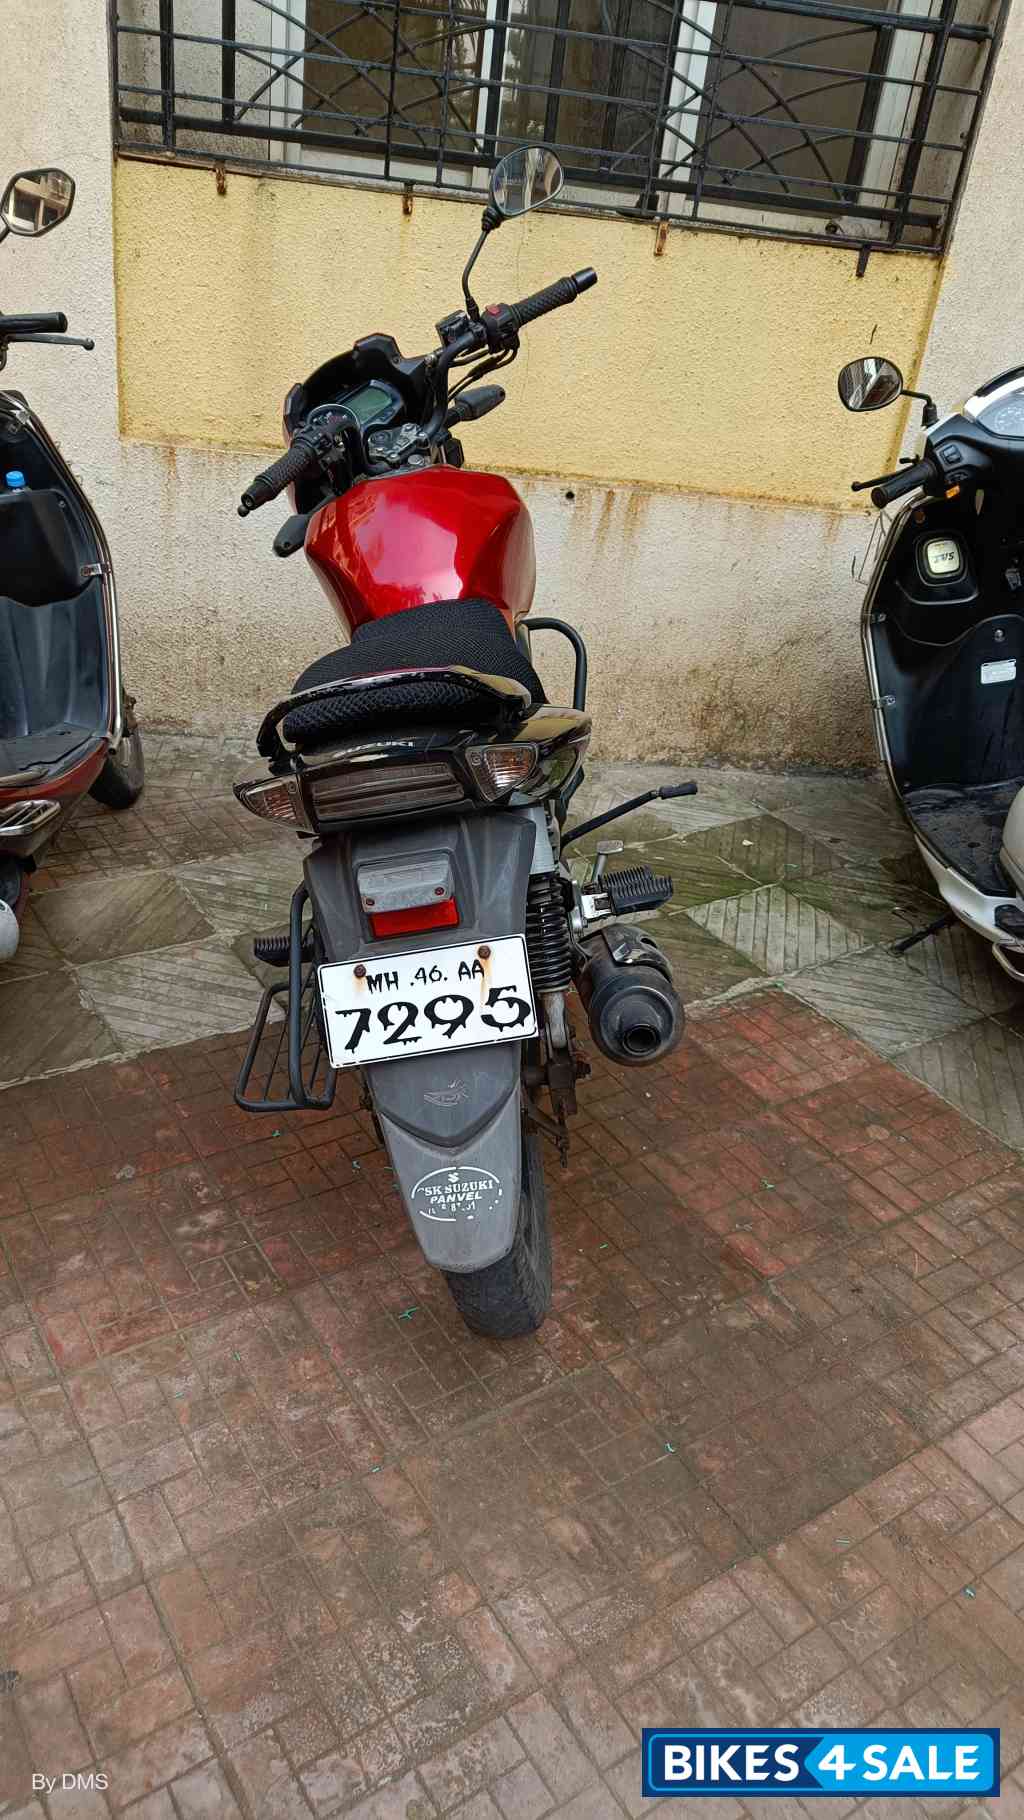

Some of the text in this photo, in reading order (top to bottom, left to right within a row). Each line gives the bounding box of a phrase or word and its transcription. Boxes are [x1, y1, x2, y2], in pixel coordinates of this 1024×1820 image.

[366, 971, 399, 994] MH
[458, 959, 485, 982] AA
[335, 985, 531, 1053] 7295
[424, 1180, 493, 1196] SK SUZUKI
[430, 1191, 482, 1204] PANVEL
